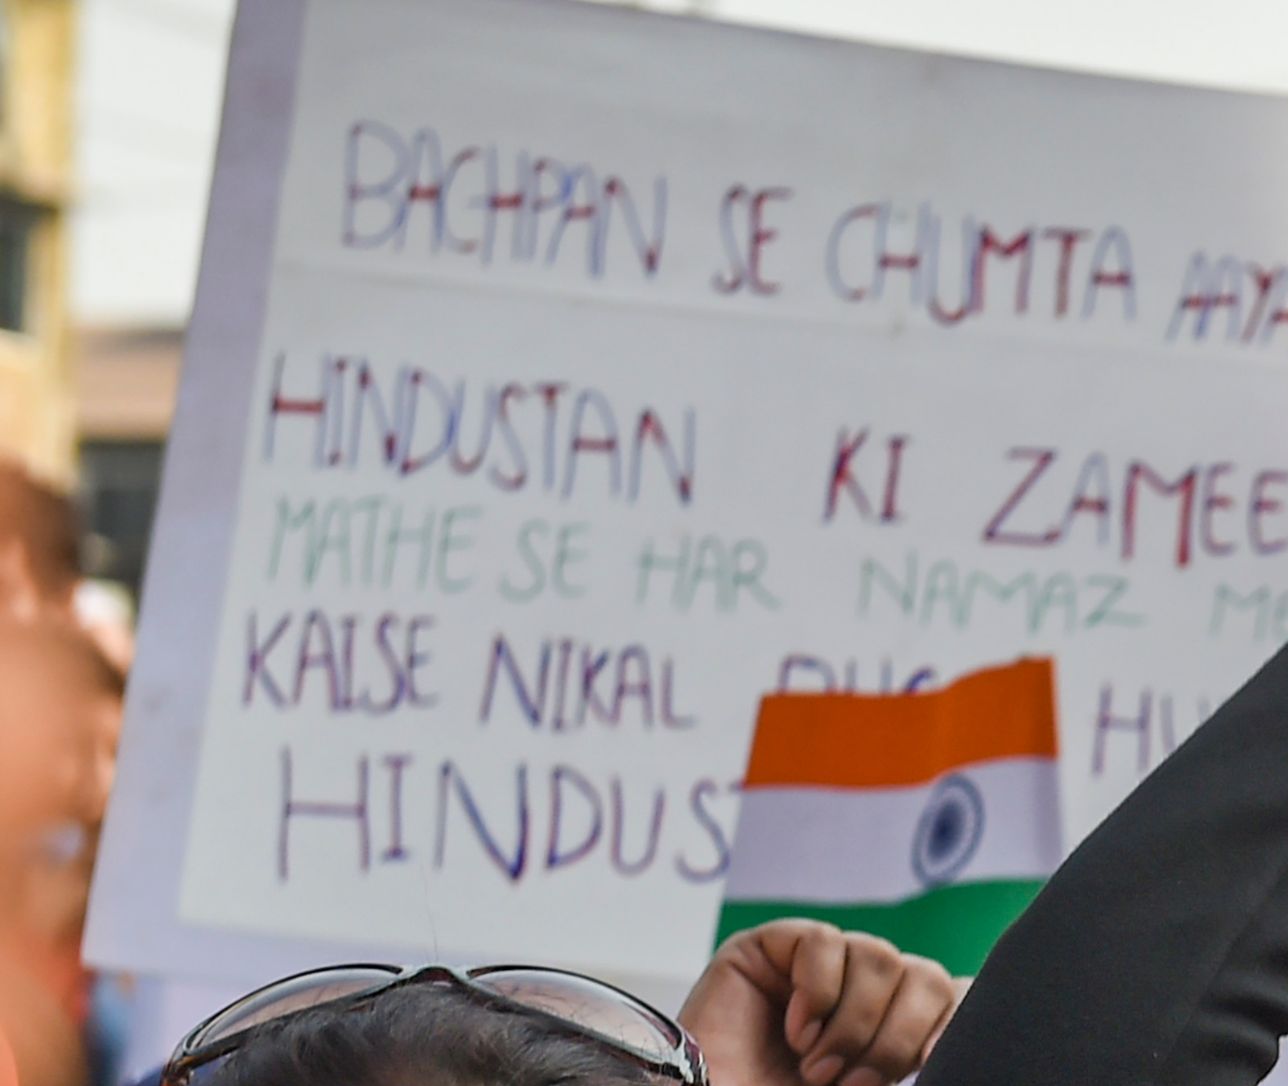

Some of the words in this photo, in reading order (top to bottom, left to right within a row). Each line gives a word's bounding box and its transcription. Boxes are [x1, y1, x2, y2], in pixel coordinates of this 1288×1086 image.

[341, 119, 669, 280] BACHPAN
[712, 184, 793, 296] SE
[825, 200, 1137, 328] CHUMTA
[264, 351, 698, 506] HINDUSTAN
[822, 424, 912, 526] KI
[264, 493, 484, 591] MATHE
[497, 519, 594, 603] SE
[636, 534, 784, 612] HAR
[855, 552, 1150, 637] NAMAZ
[243, 609, 437, 711] KAISE
[478, 630, 699, 732] NIKAL
[277, 744, 748, 886] HINDUS
